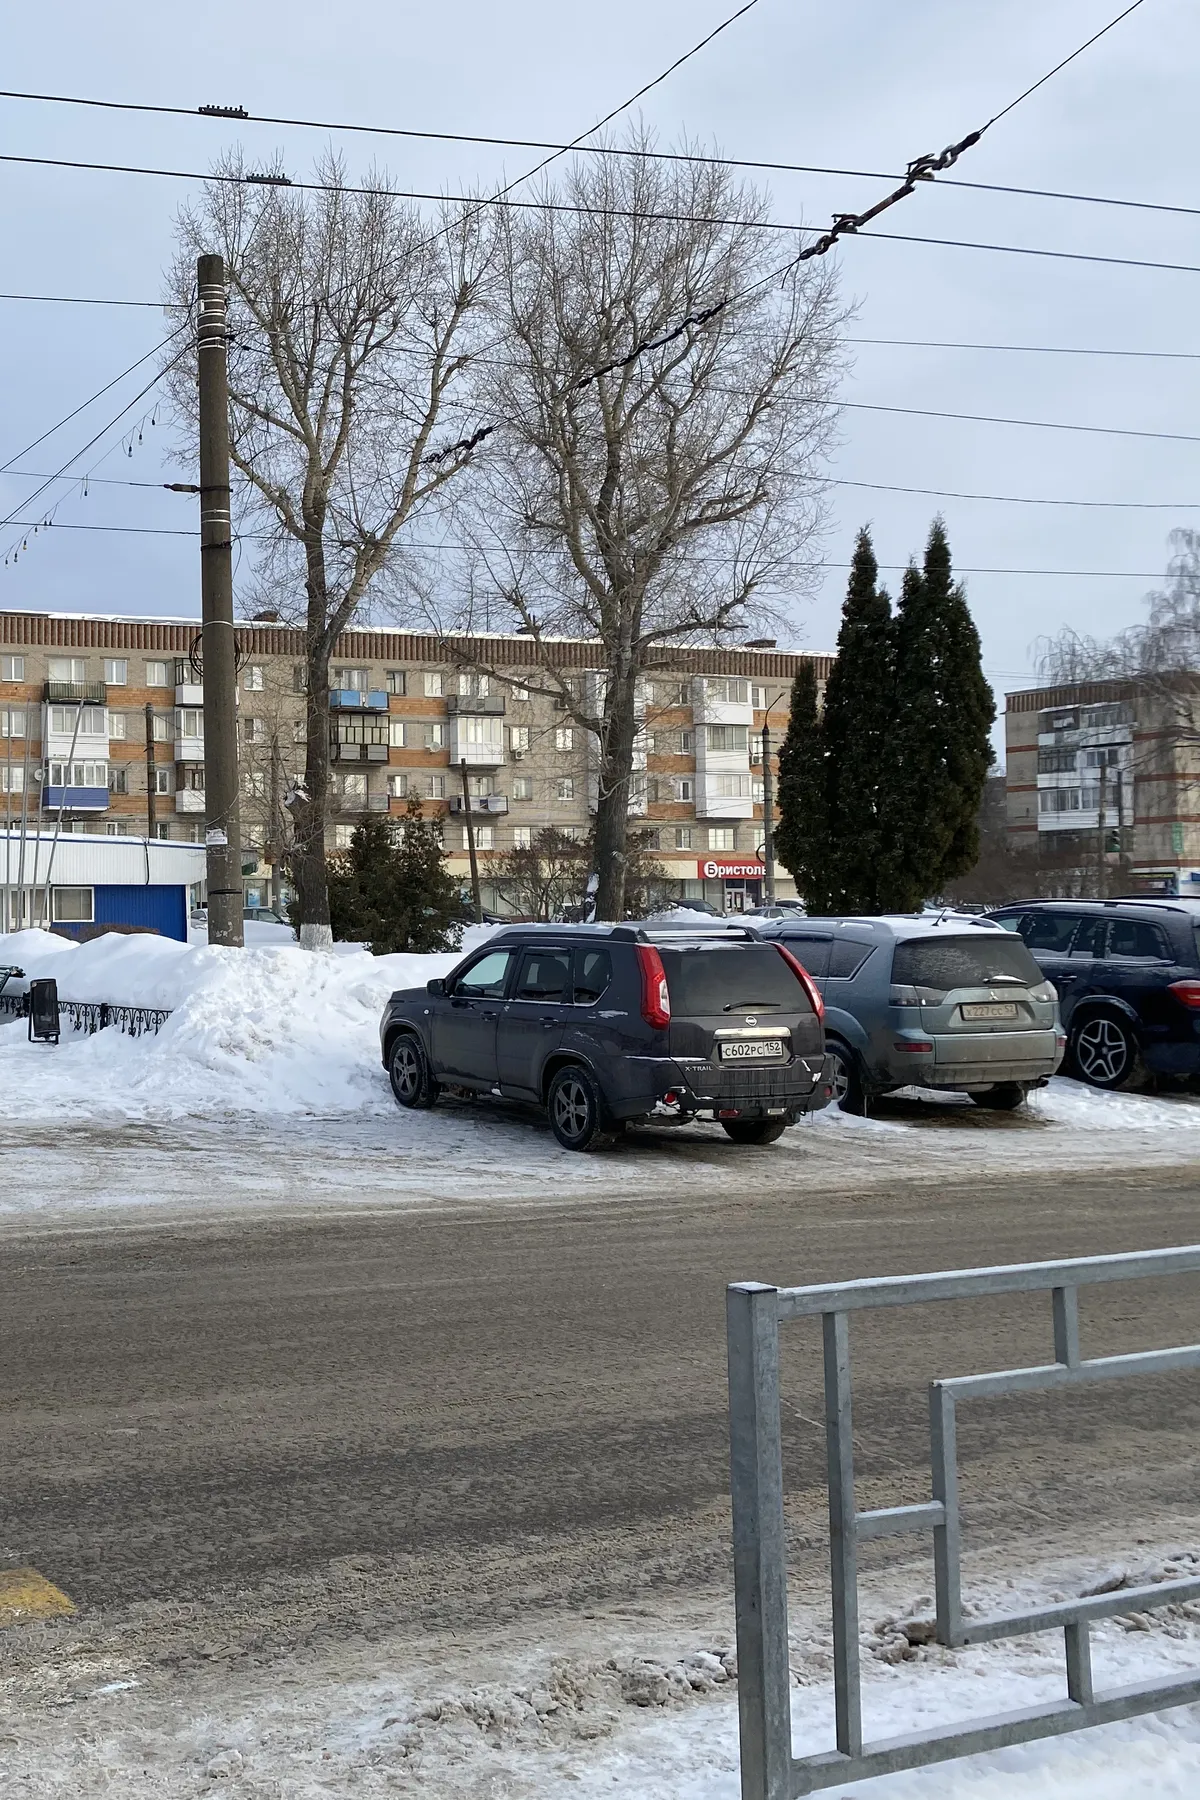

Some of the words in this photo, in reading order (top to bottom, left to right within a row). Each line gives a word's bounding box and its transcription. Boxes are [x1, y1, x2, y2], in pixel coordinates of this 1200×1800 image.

[704, 861, 766, 878] Бристоль
[1004, 1005, 1014, 1013] 52
[765, 1042, 780, 1051] 152
